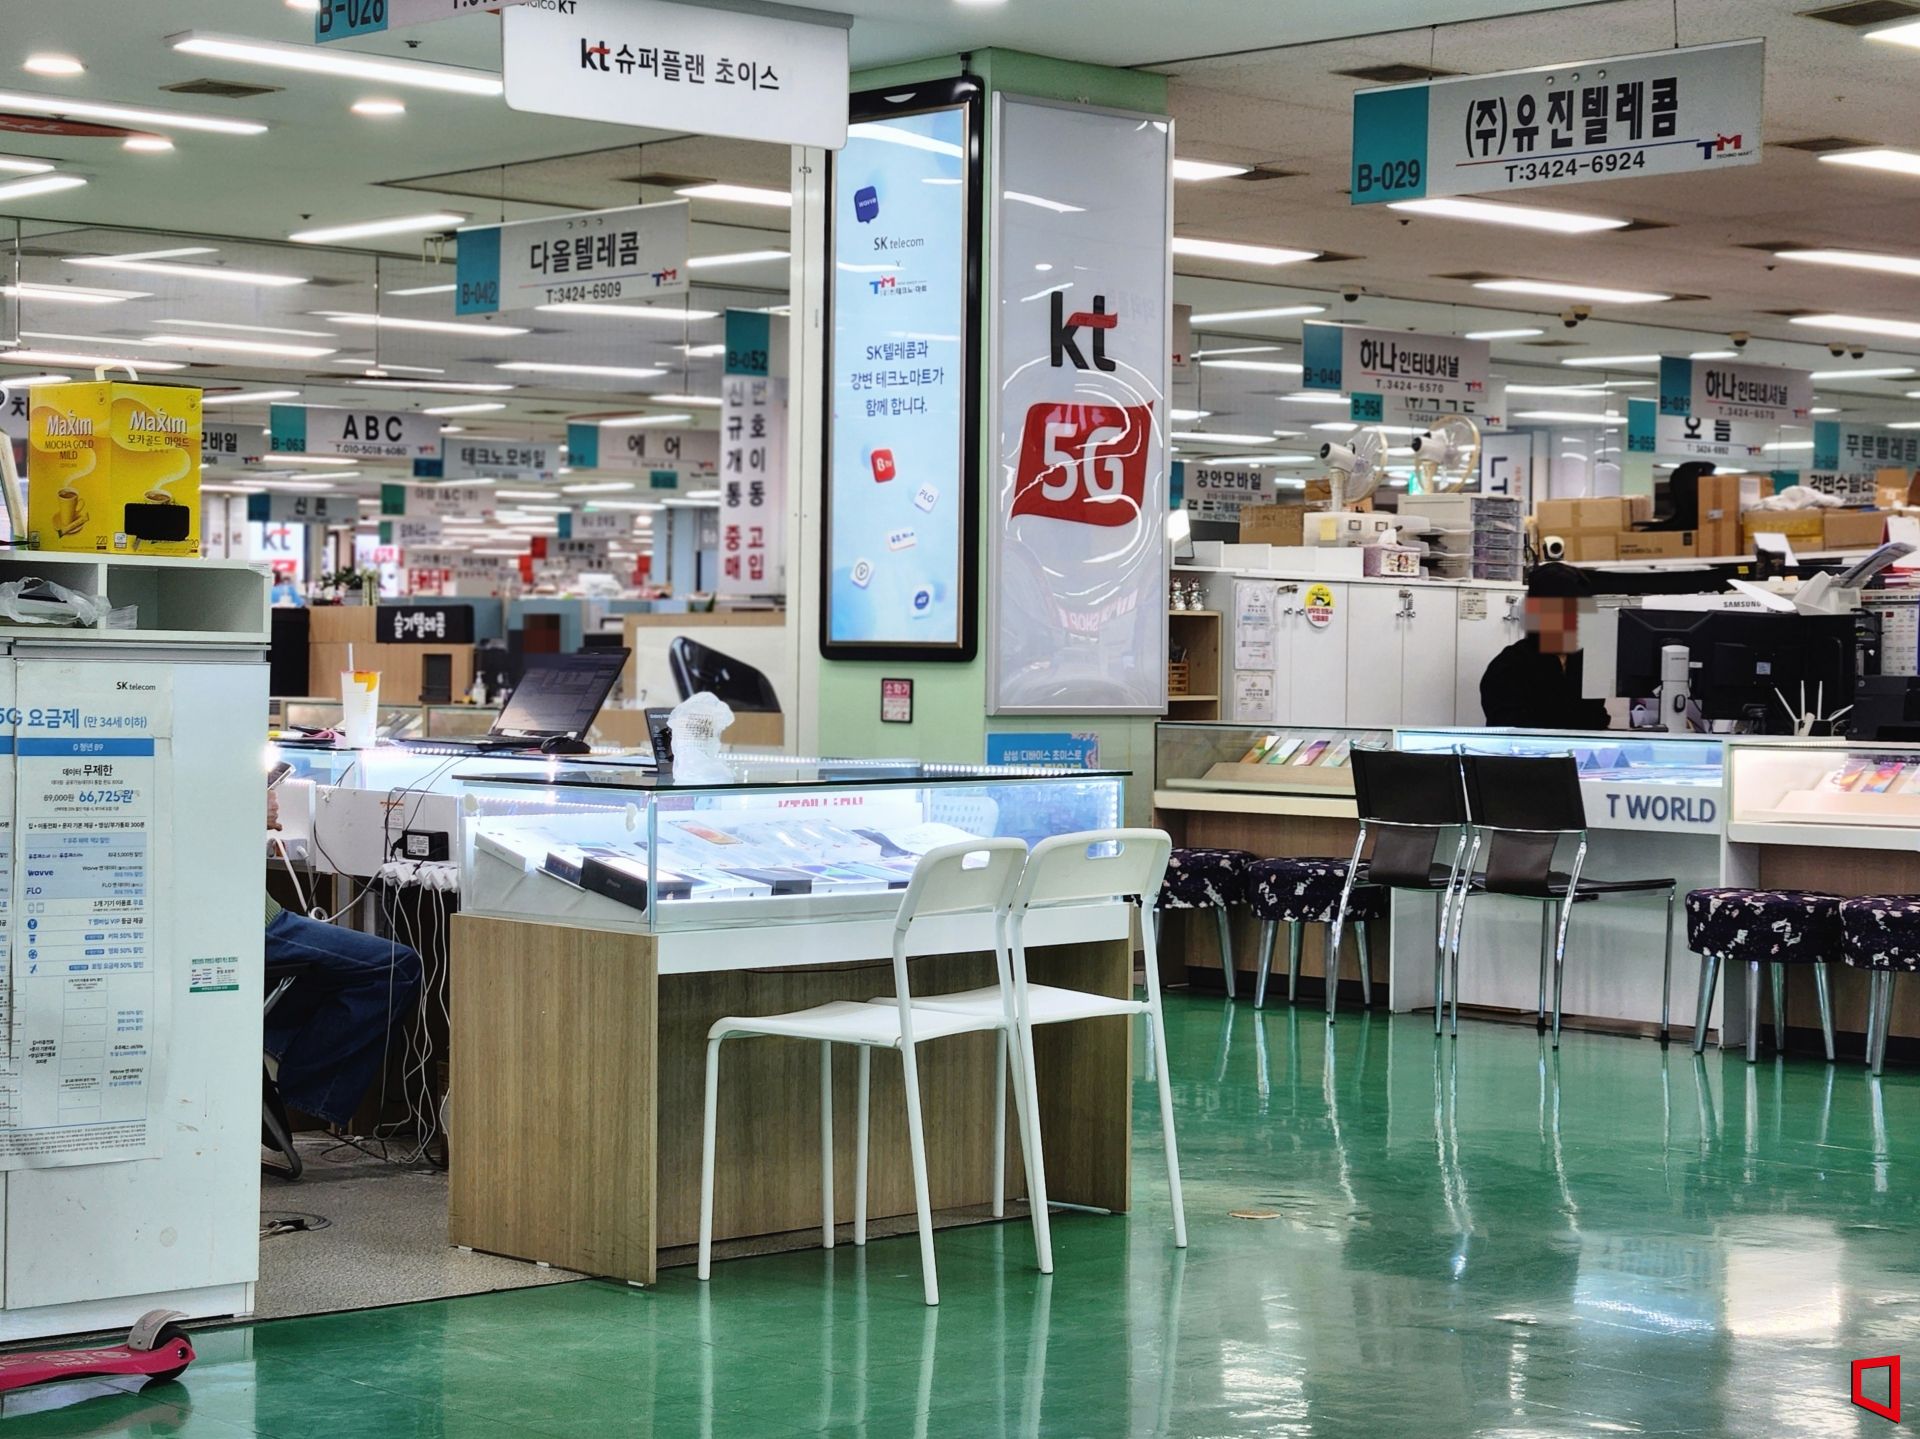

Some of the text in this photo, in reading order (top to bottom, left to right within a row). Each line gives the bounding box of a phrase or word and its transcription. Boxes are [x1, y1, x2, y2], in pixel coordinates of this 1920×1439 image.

[558, 0, 577, 15] KT
[580, 38, 780, 91] kt 슈퍼플랜 초이스
[1356, 159, 1422, 193] B-029
[1504, 150, 1646, 184] T:3424-6924
[530, 231, 640, 275] 다올텔레콤
[873, 236, 925, 251] SK telecom
[461, 281, 497, 306] B-042
[545, 281, 622, 305] T:3424-6909
[1049, 290, 1118, 372] kt
[727, 351, 768, 372] B-052
[865, 339, 929, 362] SK텔레콤과
[850, 366, 945, 391] 강변 테크노마트가
[1303, 367, 1342, 386] B-040
[1376, 378, 1445, 394] T.3424-6570
[865, 395, 928, 417] 함께 합니다.
[46, 411, 94, 437] Maxim
[129, 409, 188, 434] Maxim
[45, 439, 94, 450] MOCHA GOLD
[127, 434, 190, 448] 모카골드 마일드
[271, 438, 306, 452] B-063
[59, 450, 78, 461] MILD
[461, 447, 546, 469] 테크노모바일
[1041, 421, 1126, 505] 5G
[1196, 469, 1262, 491] 장안모바일
[918, 488, 935, 504] FLO
[96, 535, 108, 545] 220
[262, 520, 291, 552] kt
[393, 611, 446, 639] 슬기텔레콤
[116, 681, 156, 691] SK telecom
[27, 708, 80, 729] 요금제
[83, 716, 98, 728] (만
[99, 716, 123, 728] 34세
[124, 716, 147, 728] 이하)
[1003, 749, 1082, 762] 삼성 디바이스 초이스로
[62, 764, 114, 777] 데이터 무제한
[78, 789, 134, 804] 66,725원
[1606, 794, 1716, 824] T WORLD
[26, 887, 42, 895] FLO
